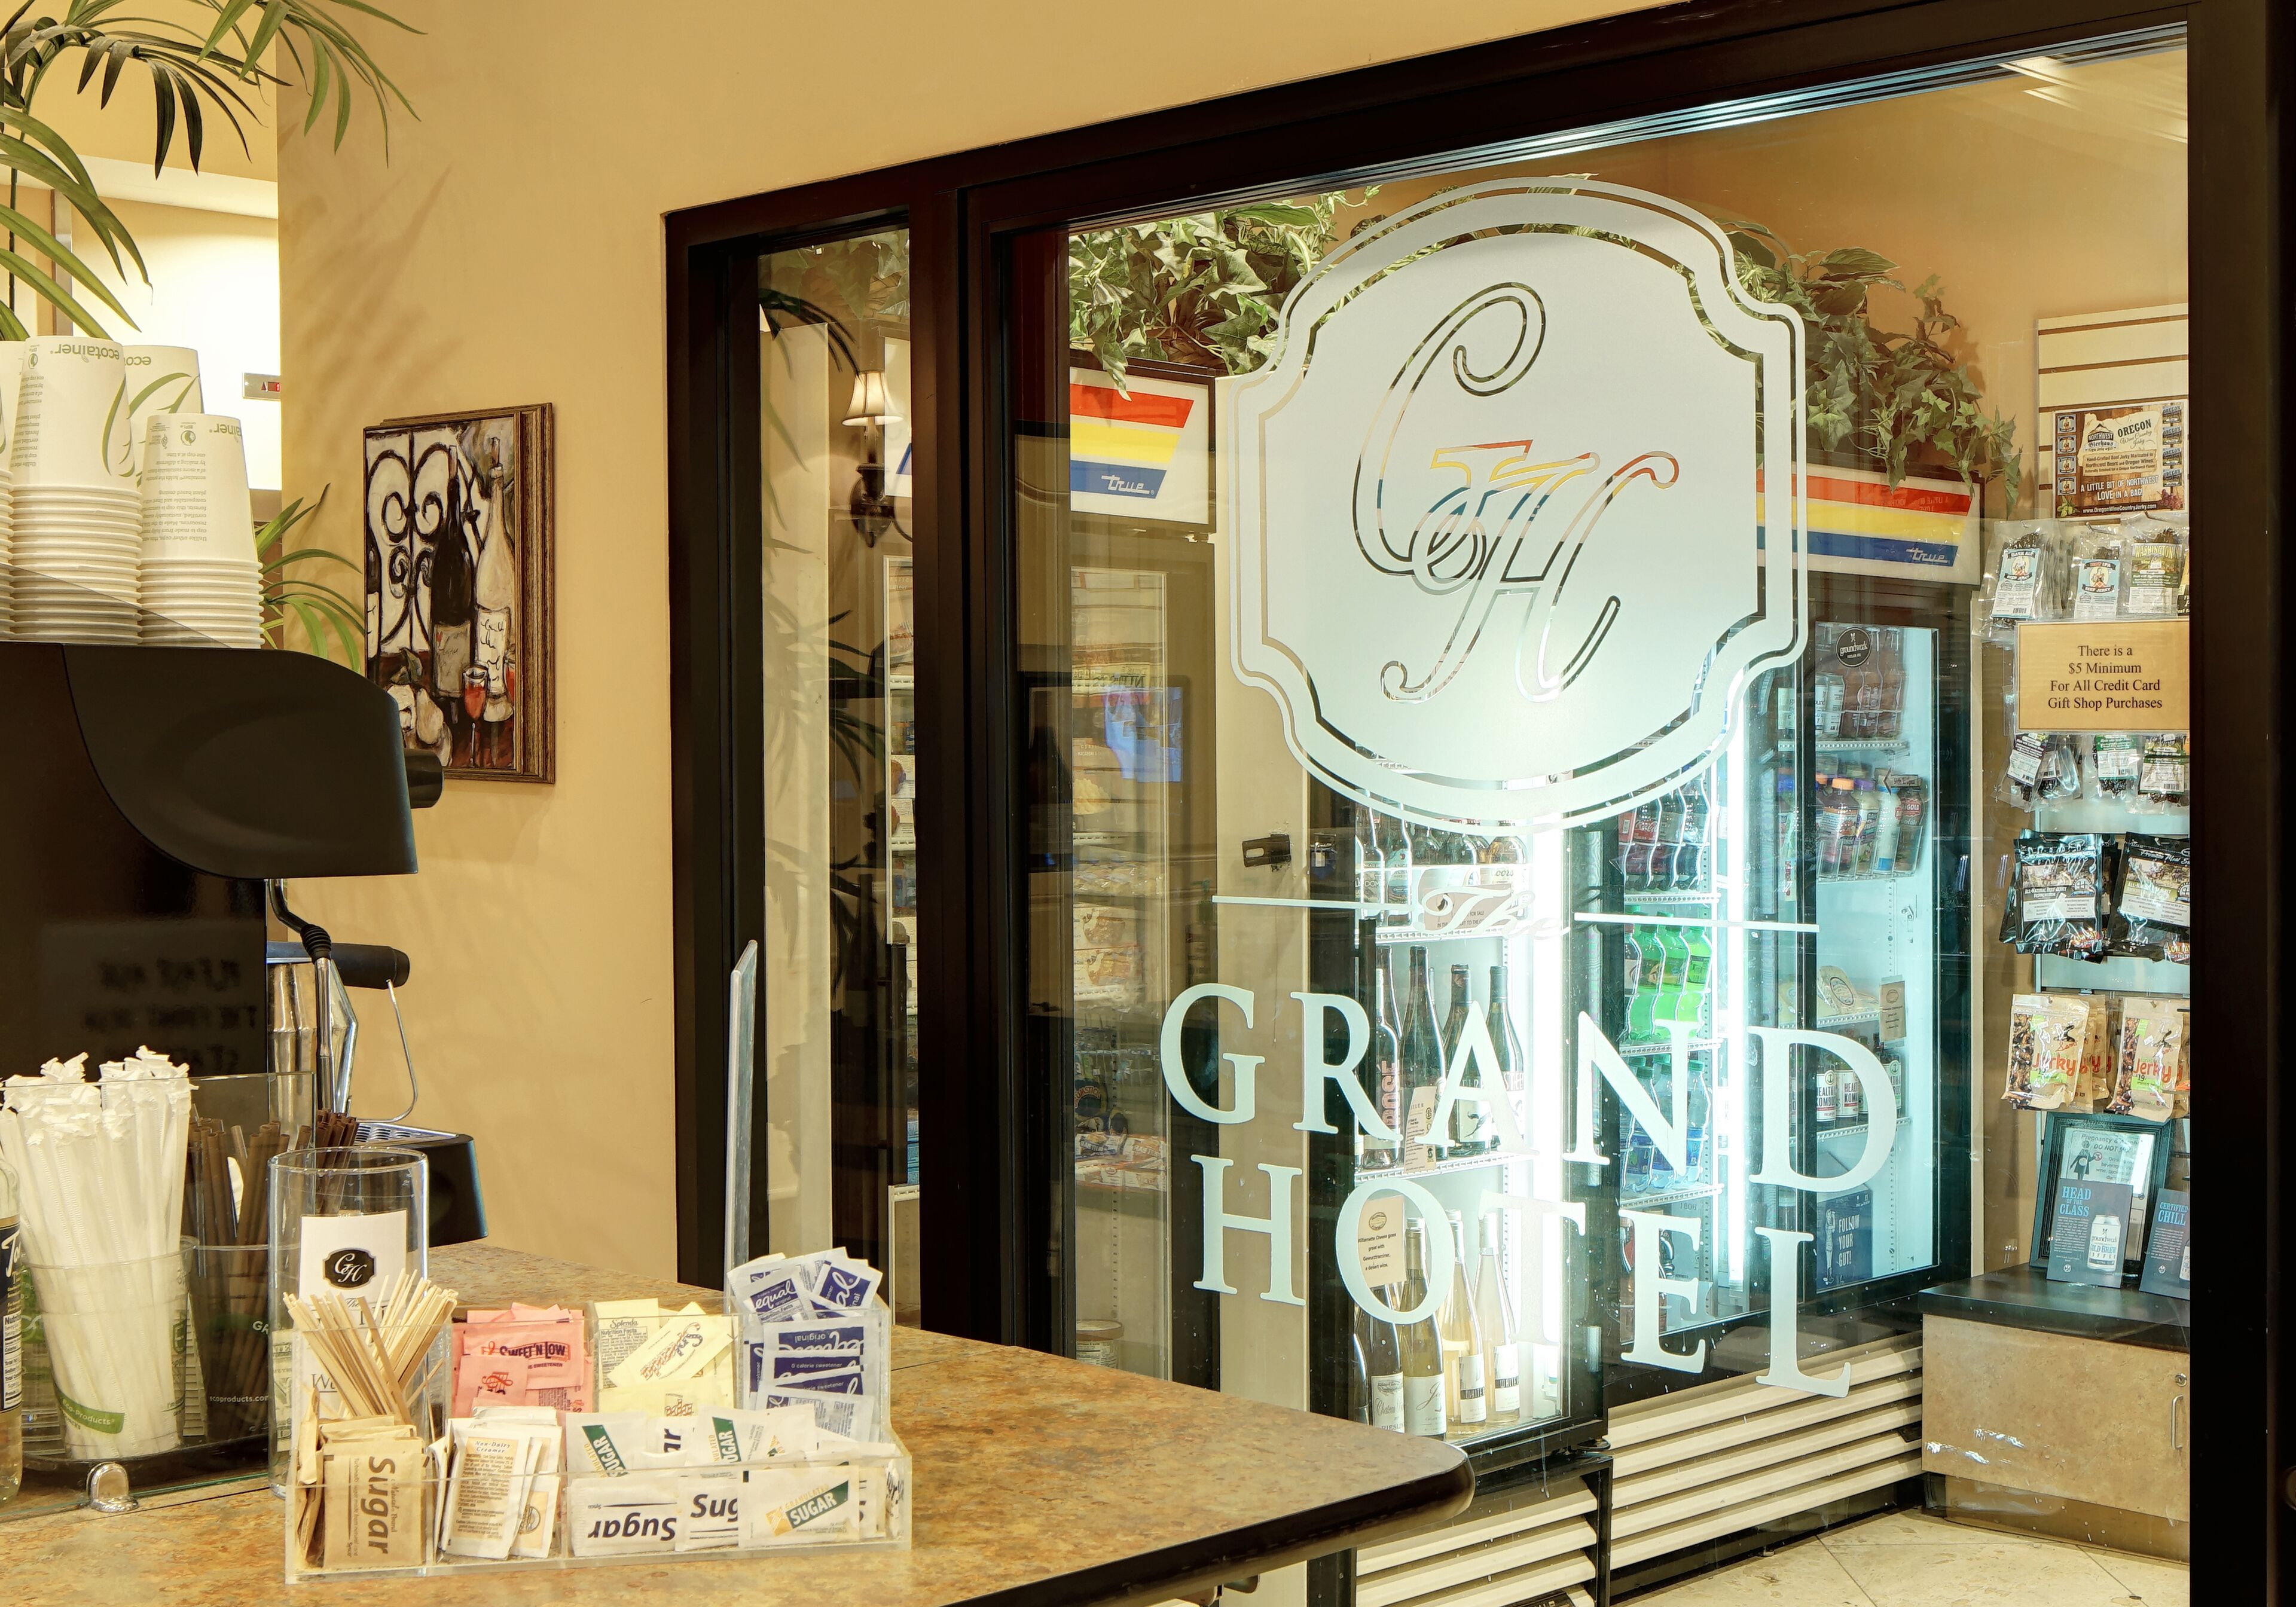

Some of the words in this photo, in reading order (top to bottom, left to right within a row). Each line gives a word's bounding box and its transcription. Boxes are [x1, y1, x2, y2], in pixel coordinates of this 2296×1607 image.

[54, 344, 120, 360] ecotainer
[2117, 419, 2152, 438] OREGON
[1101, 474, 1150, 495] true
[2086, 482, 2105, 492] LITTLE
[2126, 475, 2159, 487] NORTHWEST
[2097, 491, 2114, 501] LOVE
[1906, 546, 1949, 564] true
[2135, 545, 2173, 559] WASHINGTON
[2078, 645, 2110, 656] There
[2114, 644, 2123, 656] is
[2126, 647, 2133, 656] a
[2068, 662, 2082, 674] $5
[2086, 662, 2141, 674] Minimum
[2050, 680, 2069, 691] For
[2073, 680, 2090, 691] All
[2095, 679, 2129, 691] Credit
[2133, 679, 2160, 691] Card
[2048, 697, 2070, 708] Gift
[2074, 697, 2102, 711] Shop
[2106, 697, 2163, 708] Purchases
[1420, 884, 1571, 940] The
[1161, 982, 1898, 1193] GRAND
[2062, 1186, 2092, 1200] HEAD
[2059, 1203, 2090, 1217] CLASS
[2160, 1202, 2188, 1213] CERTIFIED
[1839, 1214, 1860, 1233] FOLLOW
[2158, 1211, 2186, 1226] CHILL
[1839, 1233, 1854, 1250] YOUR
[1839, 1250, 1852, 1267] GUT!
[1190, 1153, 1852, 1399] HOTEL
[755, 1280, 797, 1310] equal
[610, 1319, 639, 1329] Splenda
[795, 1333, 826, 1343] original
[545, 1342, 566, 1359] LOW
[475, 1441, 511, 1449] Non-Dairy
[361, 1456, 396, 1554] Sugar
[790, 1492, 837, 1526] SUGAR
[587, 1512, 677, 1542] Sugar
